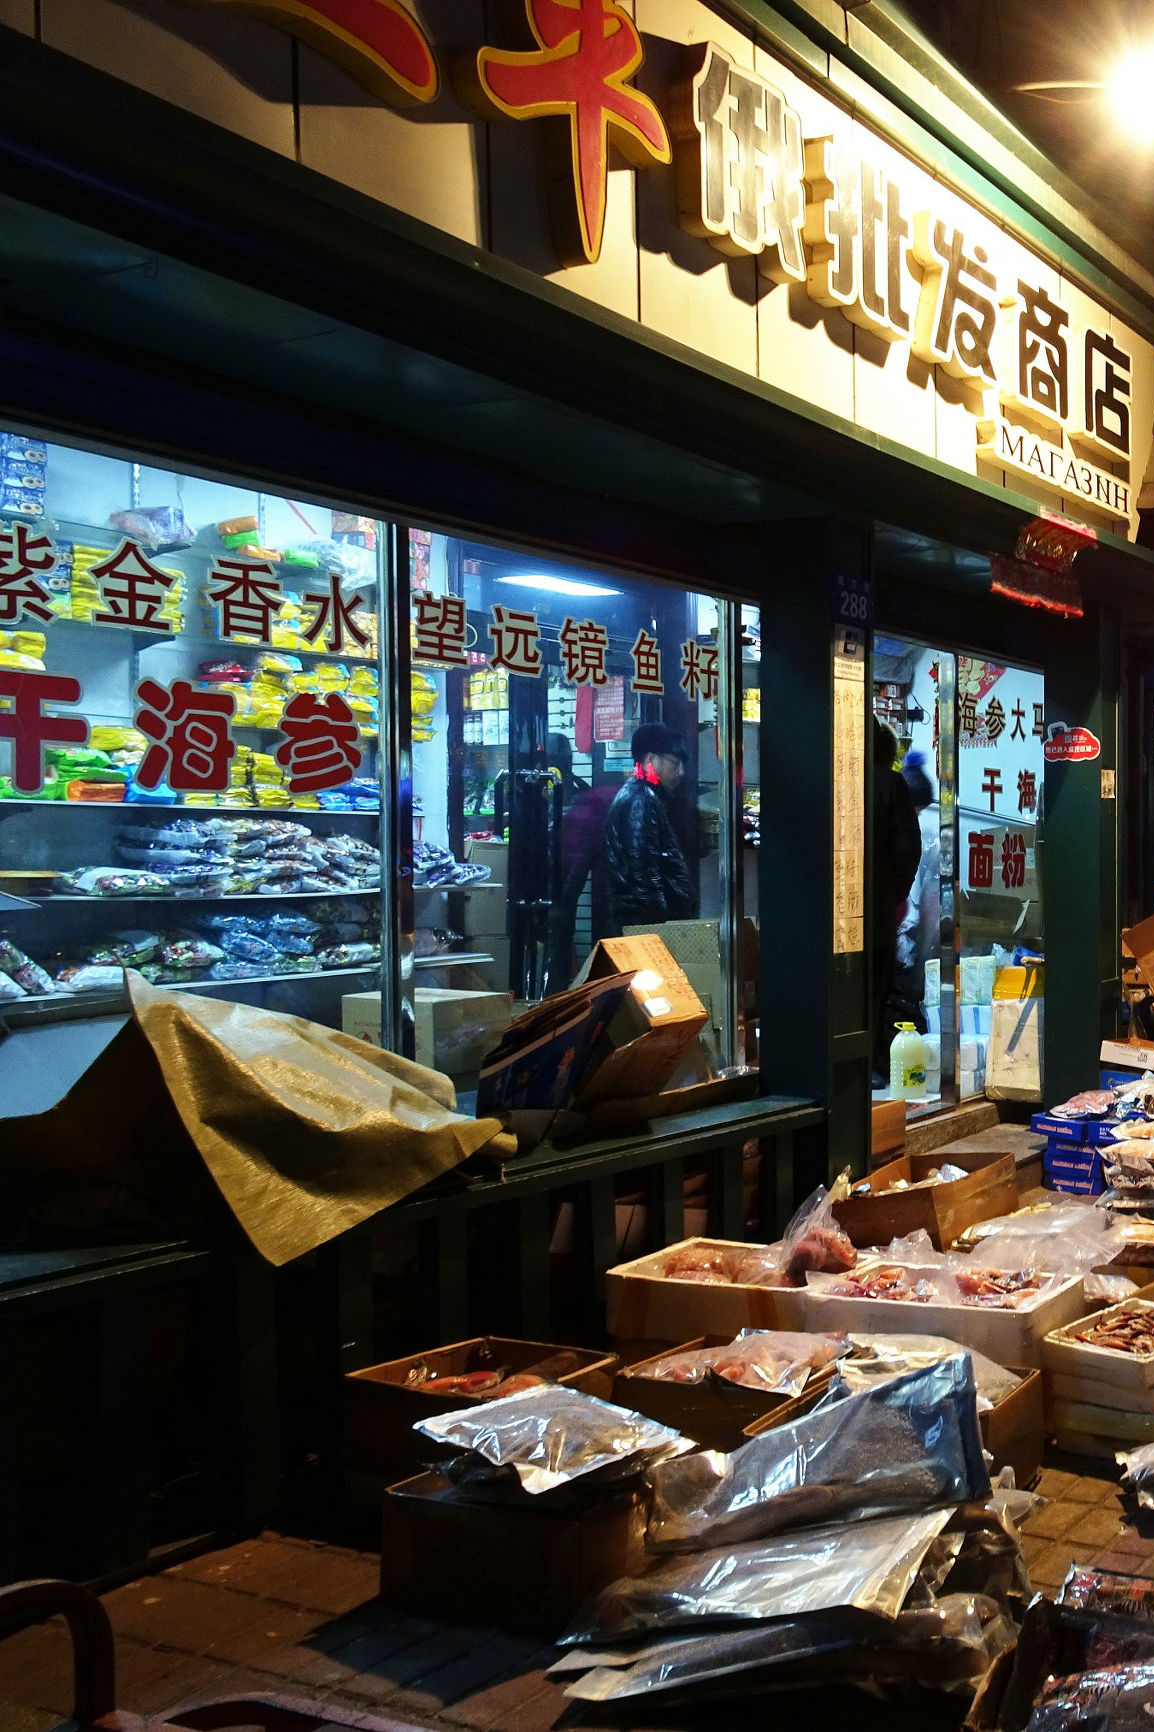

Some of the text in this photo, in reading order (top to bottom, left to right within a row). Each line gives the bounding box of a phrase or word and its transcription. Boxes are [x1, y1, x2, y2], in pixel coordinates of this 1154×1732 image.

[840, 590, 868, 620] 288
[0, 671, 363, 794] 干海参
[968, 832, 1026, 889] 面粉
